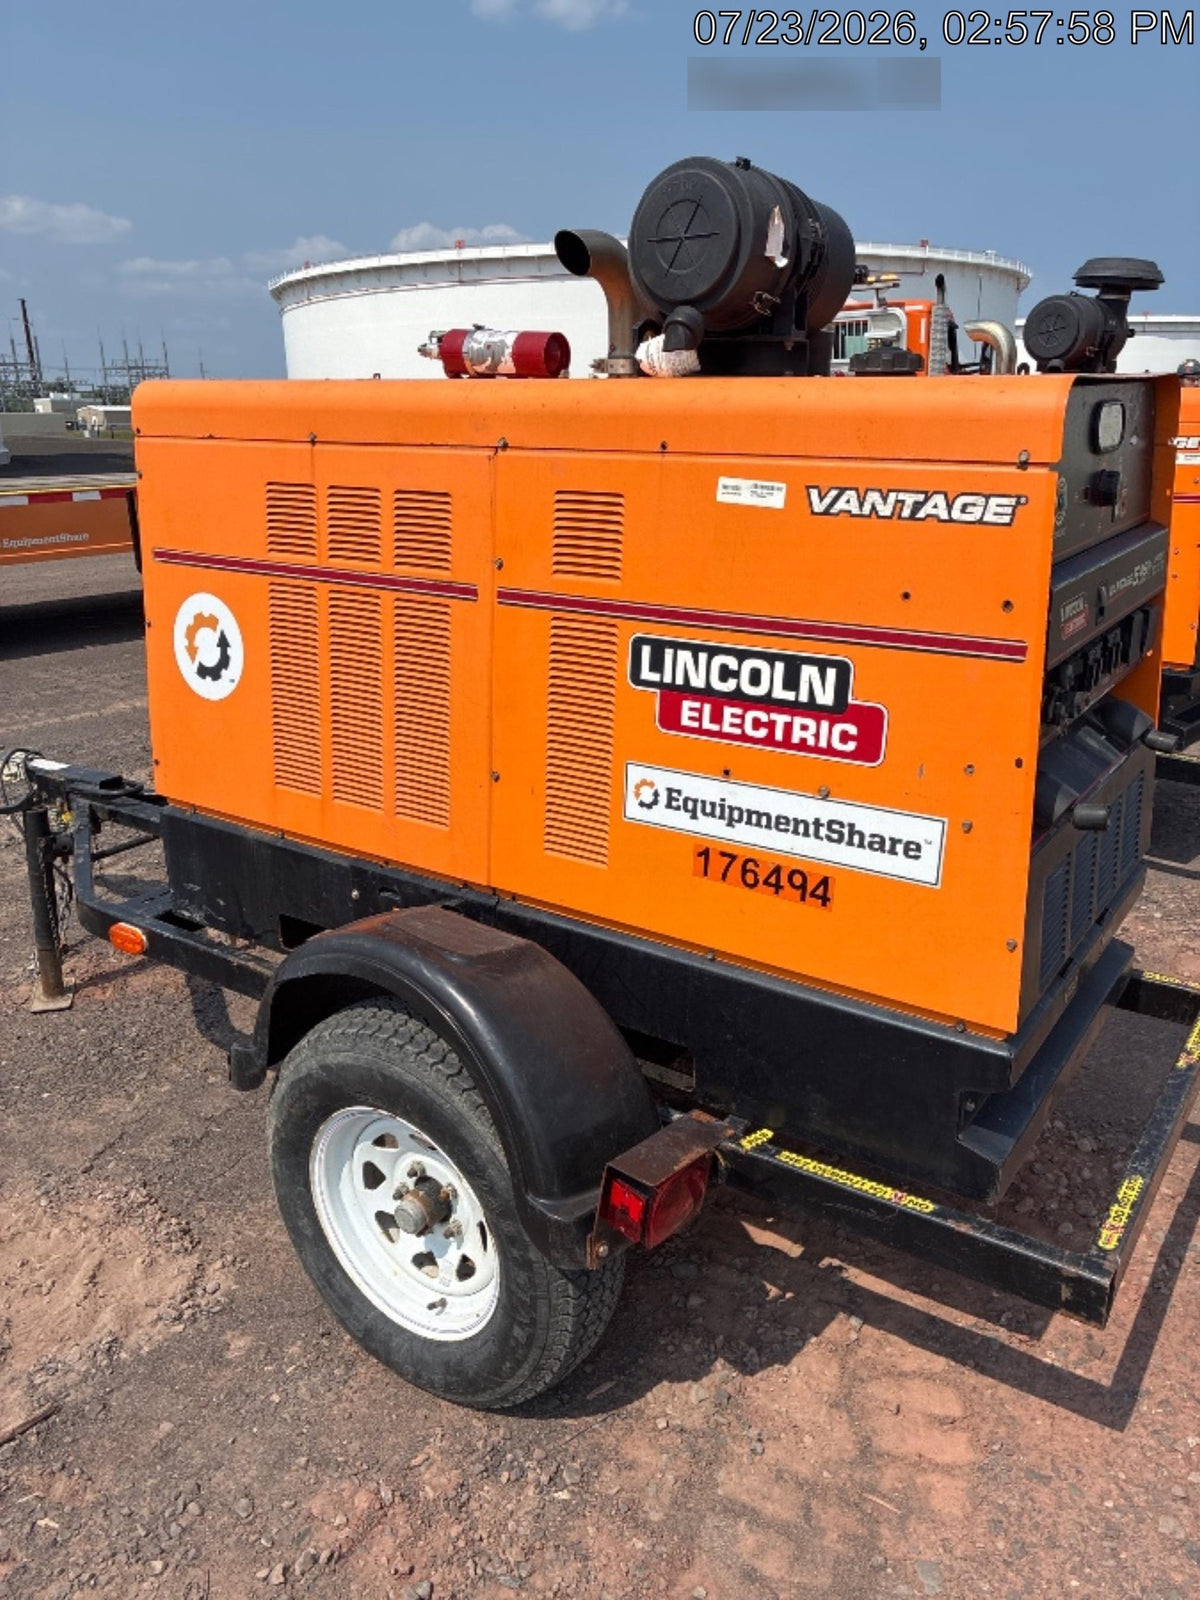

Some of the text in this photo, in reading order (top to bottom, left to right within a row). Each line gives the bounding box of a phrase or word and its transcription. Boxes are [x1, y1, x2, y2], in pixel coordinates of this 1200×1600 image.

[3, 533, 89, 548] EquipmentShare
[639, 644, 837, 707] LINCOLN
[680, 699, 859, 752] ELECTRIC
[695, 846, 833, 908] 176494
